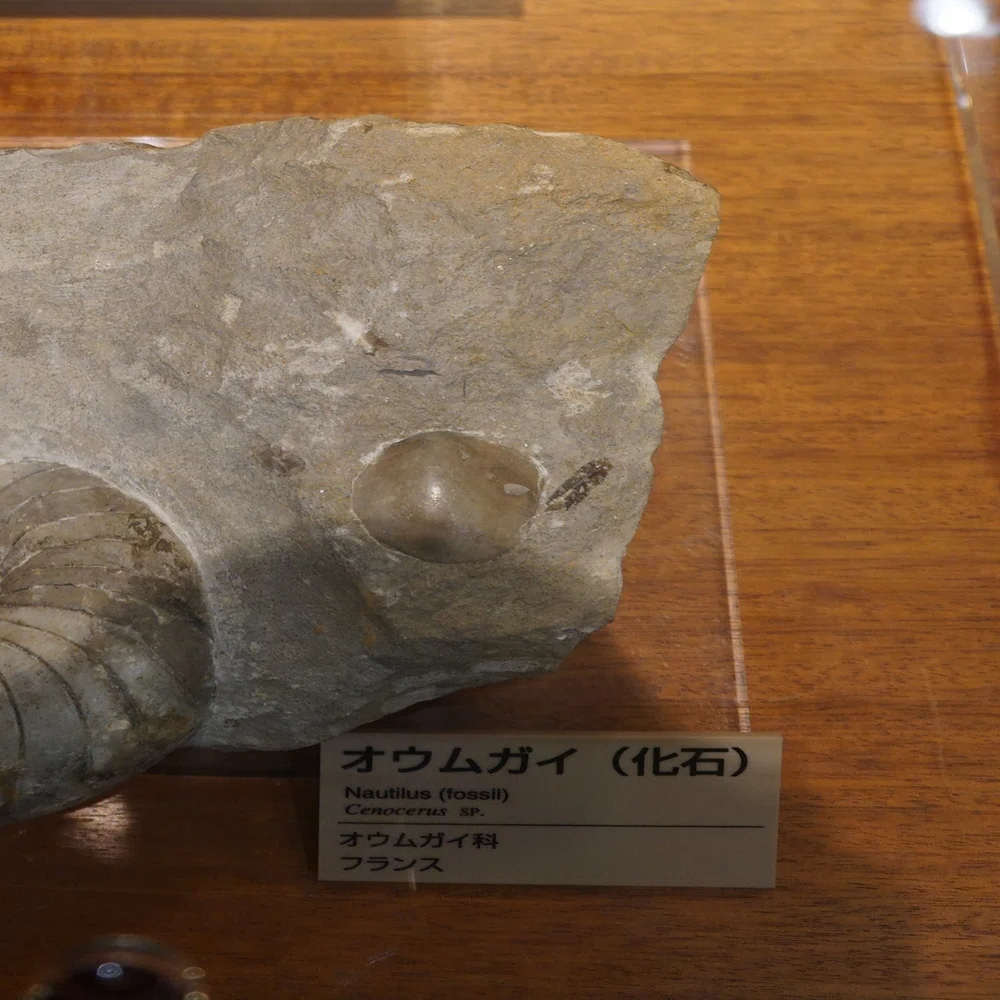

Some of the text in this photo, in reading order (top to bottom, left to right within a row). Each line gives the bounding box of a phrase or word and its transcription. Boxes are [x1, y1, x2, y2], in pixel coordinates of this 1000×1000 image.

[344, 786, 509, 803] Nautilus (fossil)
[344, 803, 448, 817] Cenocerus
[339, 832, 499, 850] オウムガイ科
[340, 855, 445, 873] フランス
